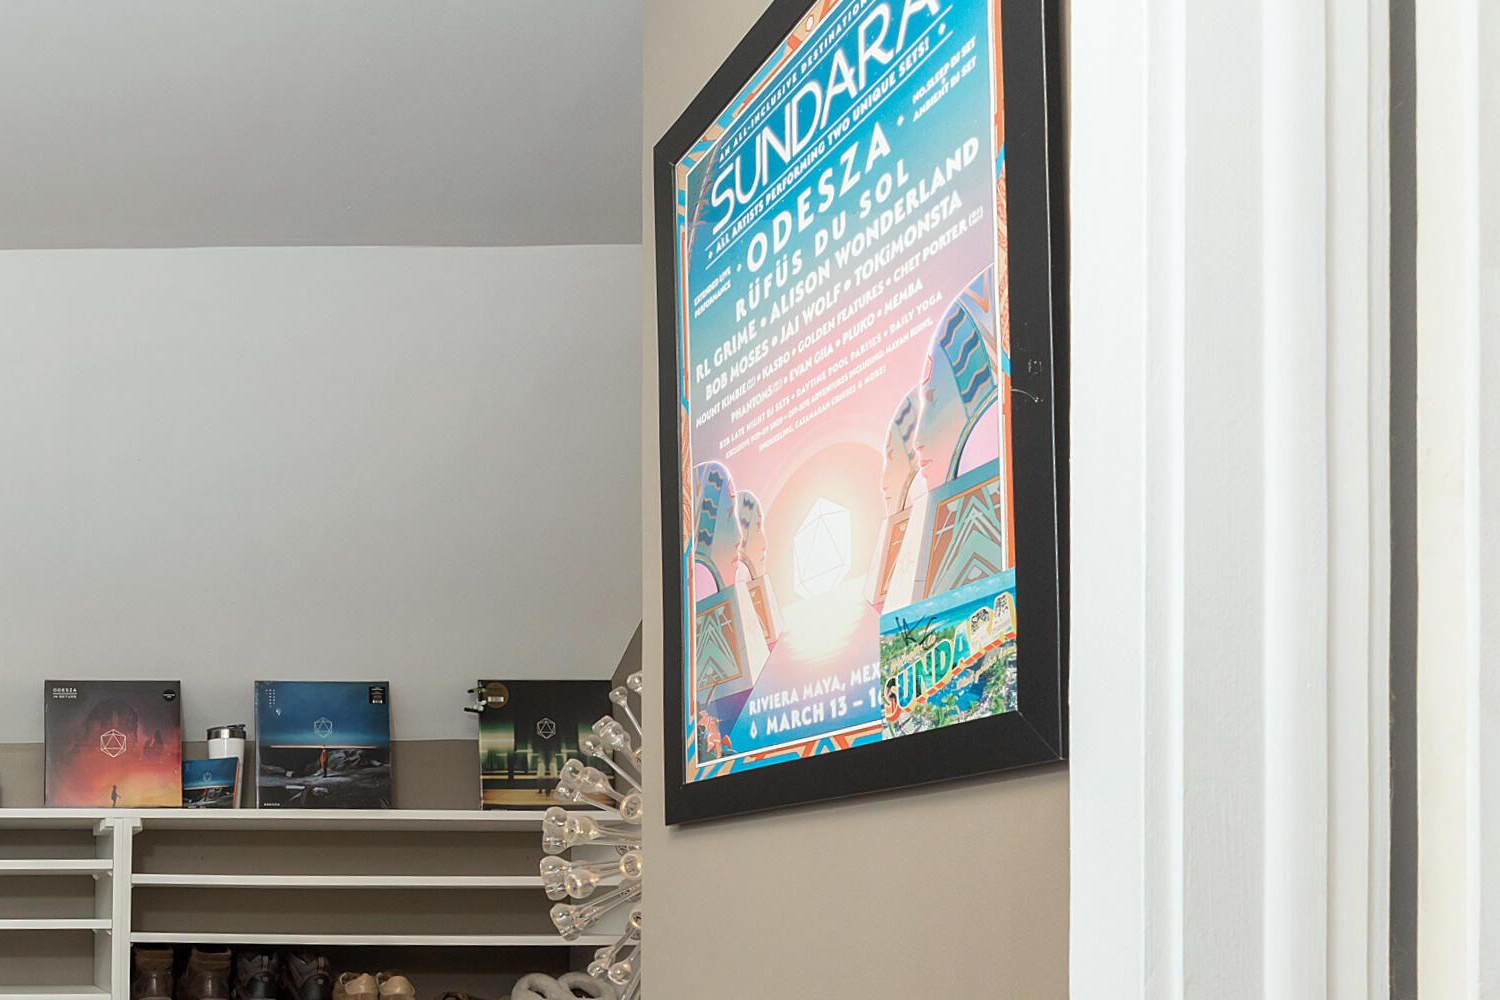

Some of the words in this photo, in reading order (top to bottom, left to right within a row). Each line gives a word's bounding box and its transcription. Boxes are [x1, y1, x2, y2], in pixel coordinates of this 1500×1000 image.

[711, 0, 940, 235] SUNDARA
[716, 233, 730, 254] ALL
[732, 203, 764, 238] ARTISTS
[766, 142, 825, 205] PERFORMING
[827, 117, 850, 146] TWO
[852, 71, 897, 121] UNIQUE
[898, 36, 930, 77] SETS!
[719, 147, 730, 162] AN
[733, 72, 798, 147] ALL-INCLUSIVE
[696, 358, 711, 384] RL
[714, 319, 757, 367] GRIME
[770, 258, 830, 324] ALISON
[834, 137, 979, 269] WONDERLAND
[736, 249, 802, 322] RÜFÜS
[815, 210, 846, 257] DU
[859, 158, 909, 219] SOL
[747, 121, 891, 272] ODESZA
[696, 402, 721, 429] MOUNT
[721, 383, 747, 410] KIMBIE
[762, 351, 790, 380] KASBO
[797, 317, 836, 352] GOLDEN
[837, 280, 884, 325] FEATURES
[893, 252, 921, 283] CHET
[923, 219, 968, 262] PORTER
[705, 370, 728, 401] BOB
[730, 339, 769, 382] MOSES
[780, 315, 799, 344] JAI
[802, 282, 841, 325] WOLF
[789, 357, 813, 382] EVAN
[842, 312, 875, 345] PLUKO
[884, 277, 923, 315] MEMBA
[889, 309, 914, 335] DAILY
[916, 291, 942, 315] YOGA
[749, 687, 799, 716] RIVIERA
[803, 675, 846, 700] MAYA,
[766, 702, 825, 735] MARCH
[884, 591, 1017, 722] SUNDARA
